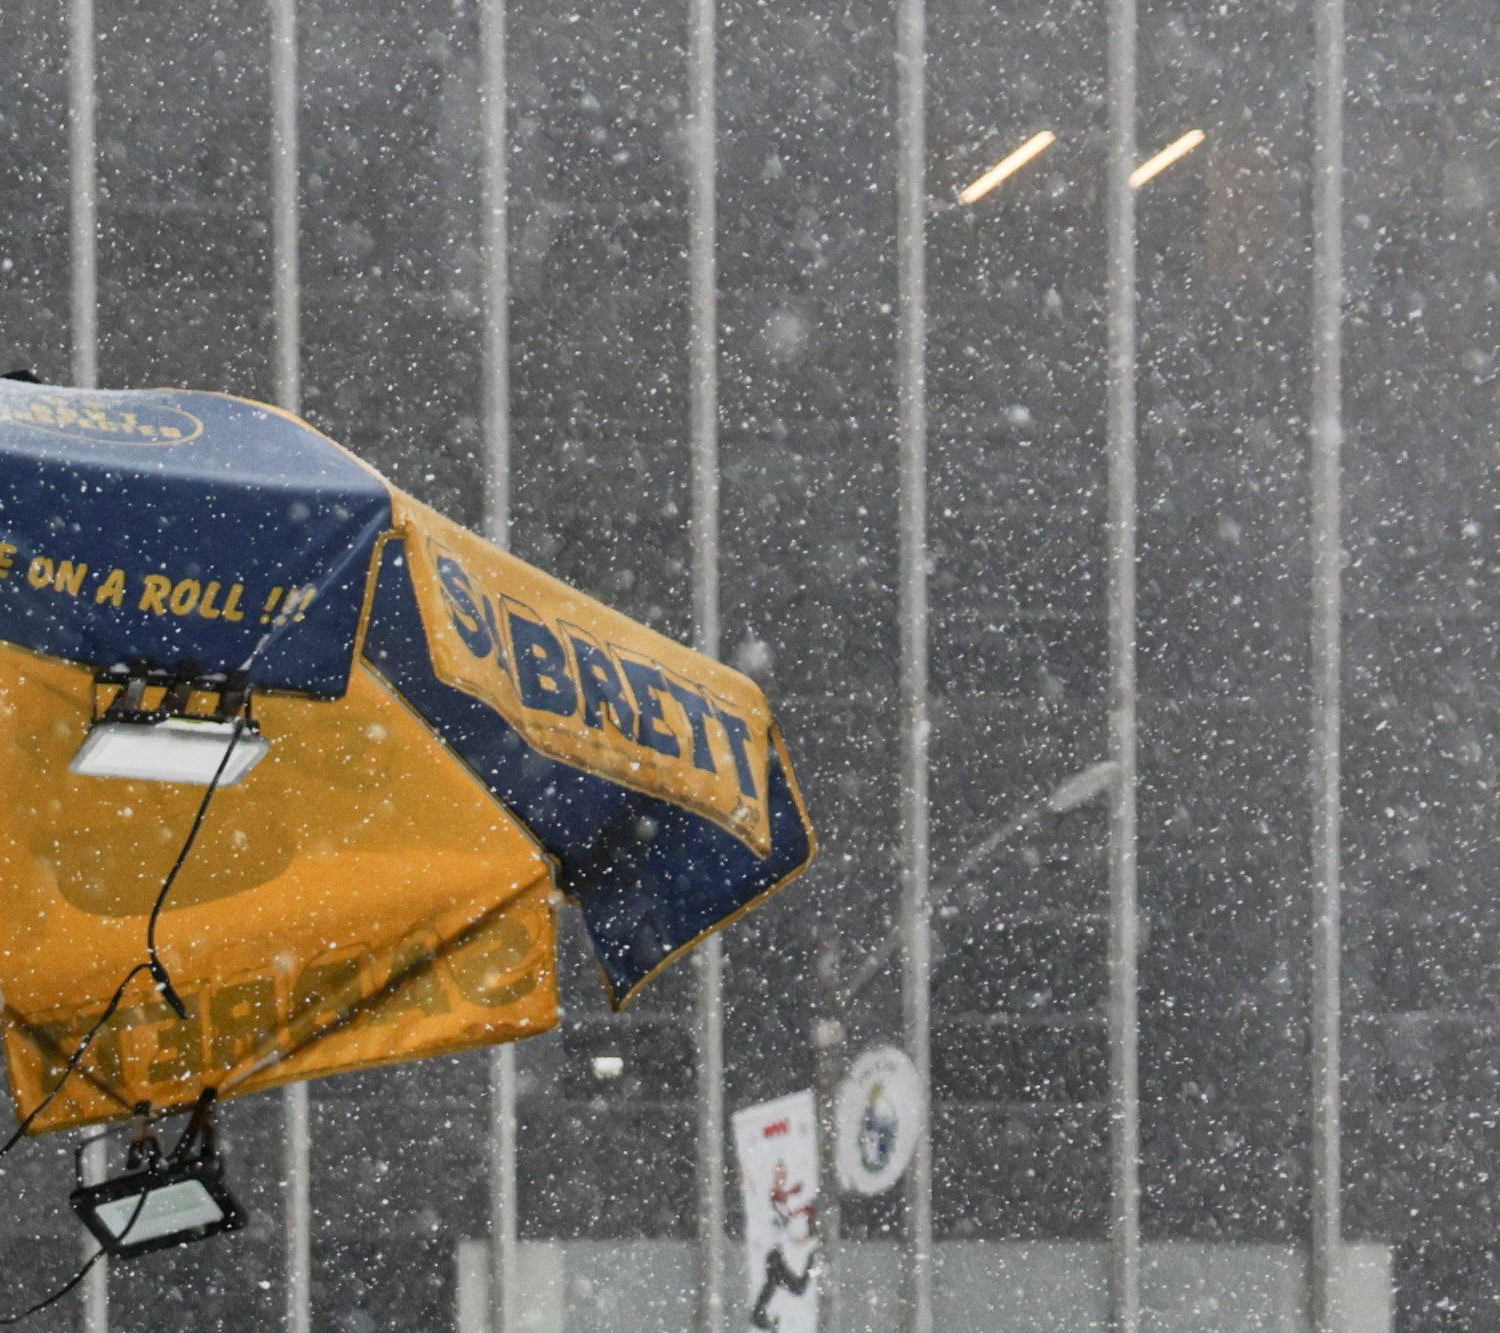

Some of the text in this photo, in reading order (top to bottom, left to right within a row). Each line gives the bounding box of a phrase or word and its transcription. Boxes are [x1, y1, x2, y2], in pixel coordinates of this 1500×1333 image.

[27, 555, 89, 598] ON
[94, 567, 127, 608] A
[138, 573, 246, 623] ROLL
[430, 542, 759, 801] SBRETT
